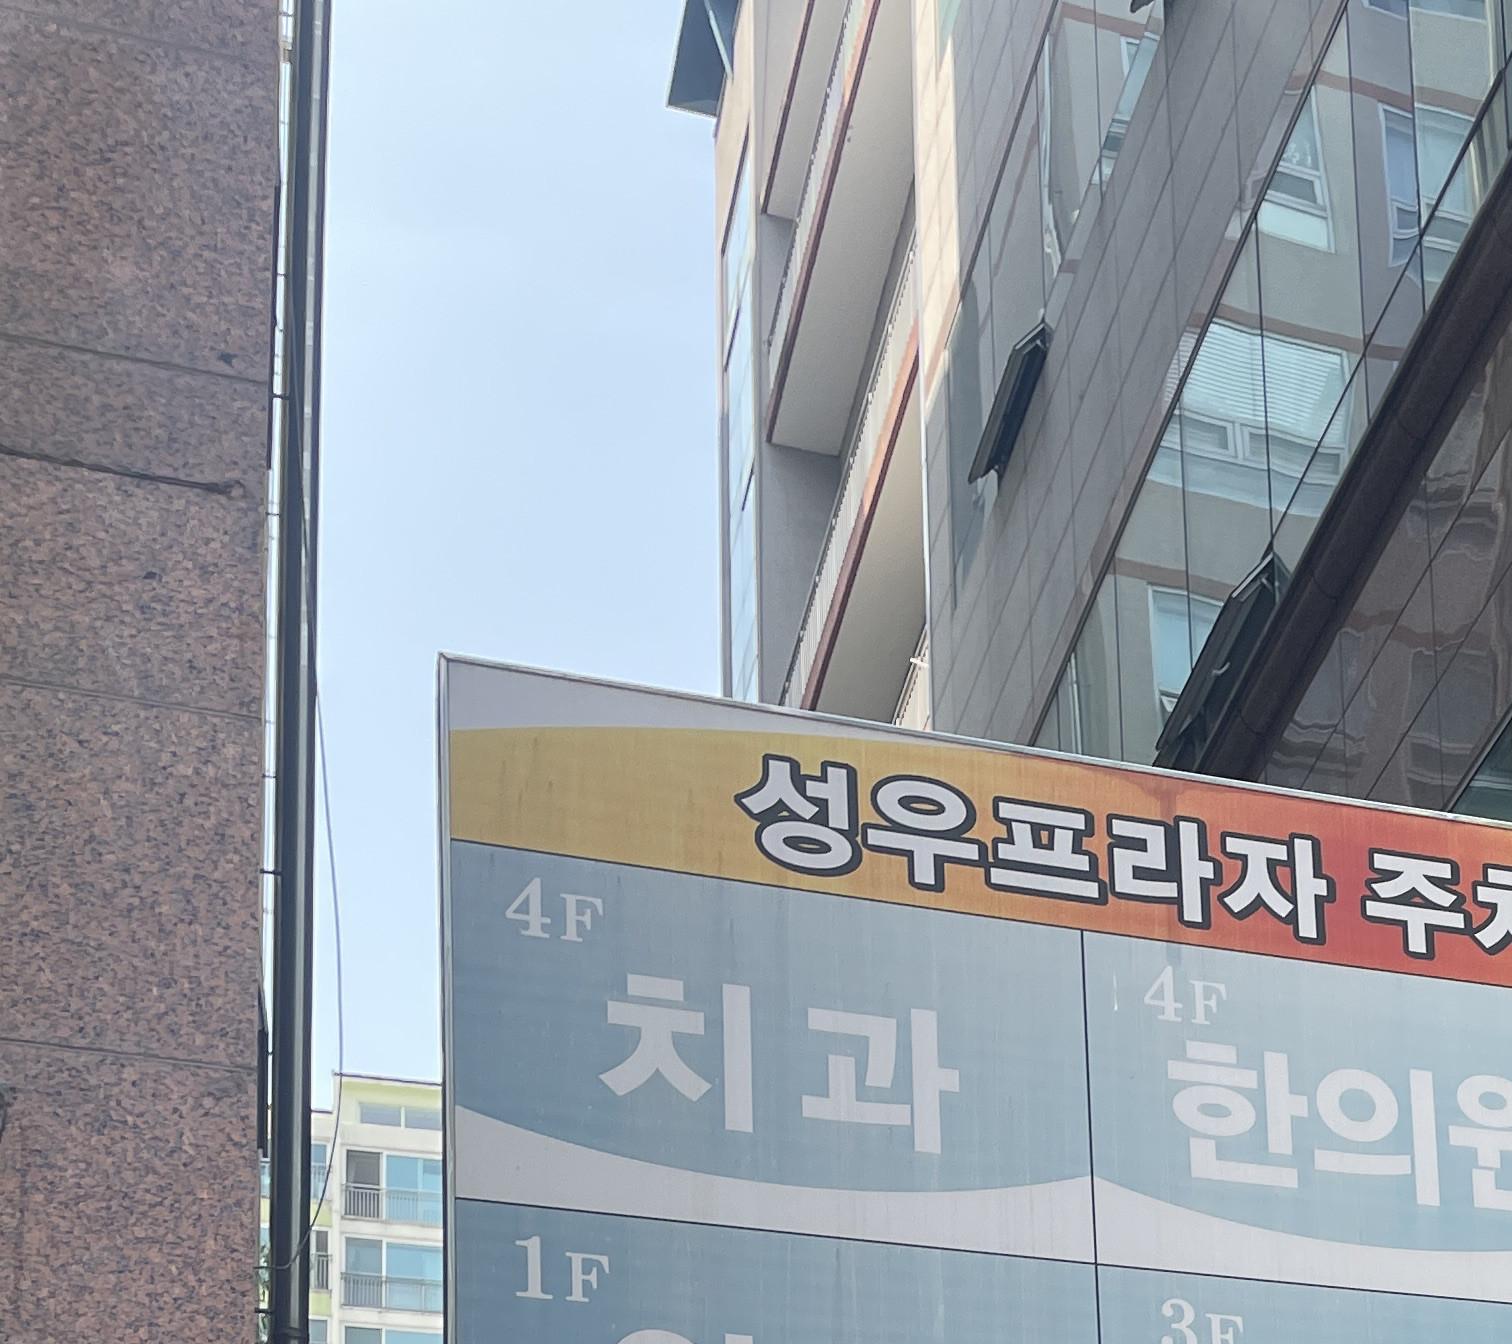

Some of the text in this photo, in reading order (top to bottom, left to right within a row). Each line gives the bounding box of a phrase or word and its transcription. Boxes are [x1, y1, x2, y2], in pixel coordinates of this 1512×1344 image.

[734, 754, 1335, 944] 성우프라자
[504, 877, 603, 942] 4F
[1142, 965, 1227, 1026] 4F
[599, 973, 960, 1154] 치과
[514, 1235, 610, 1302] 1F
